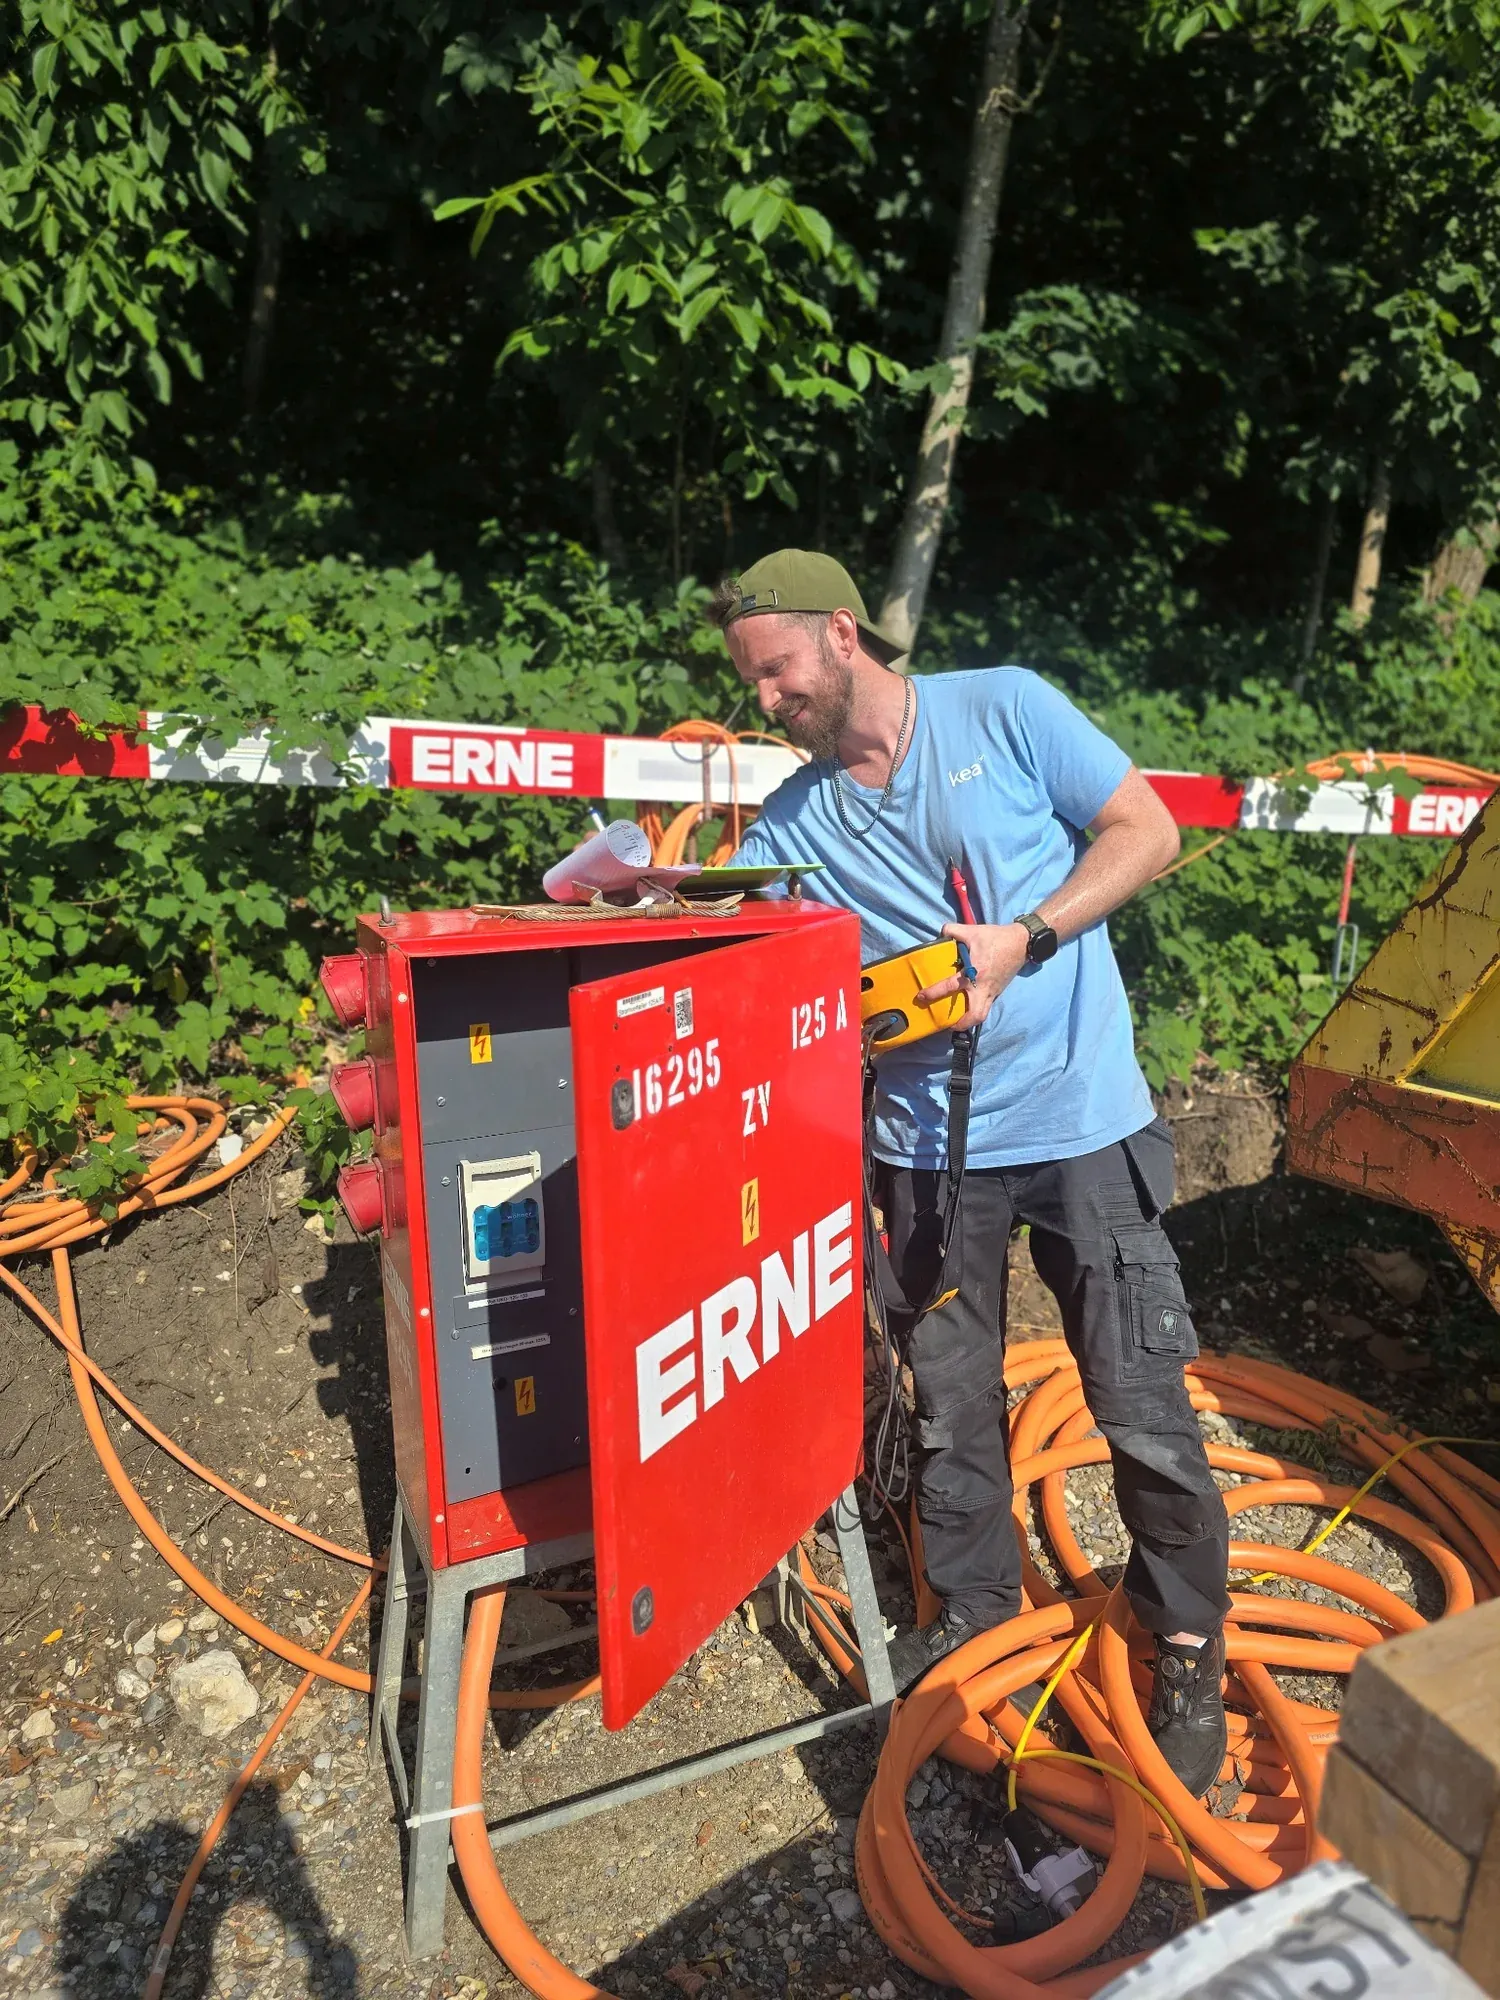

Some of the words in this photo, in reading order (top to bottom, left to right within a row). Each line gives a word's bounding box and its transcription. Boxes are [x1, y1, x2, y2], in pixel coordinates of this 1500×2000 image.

[412, 735, 574, 788] ERNE
[948, 763, 983, 787] kea
[1408, 794, 1488, 834] ERN
[792, 995, 826, 1050] 125
[835, 987, 848, 1031] A
[632, 1038, 721, 1122] 16295
[635, 1200, 853, 1464] ERNE
